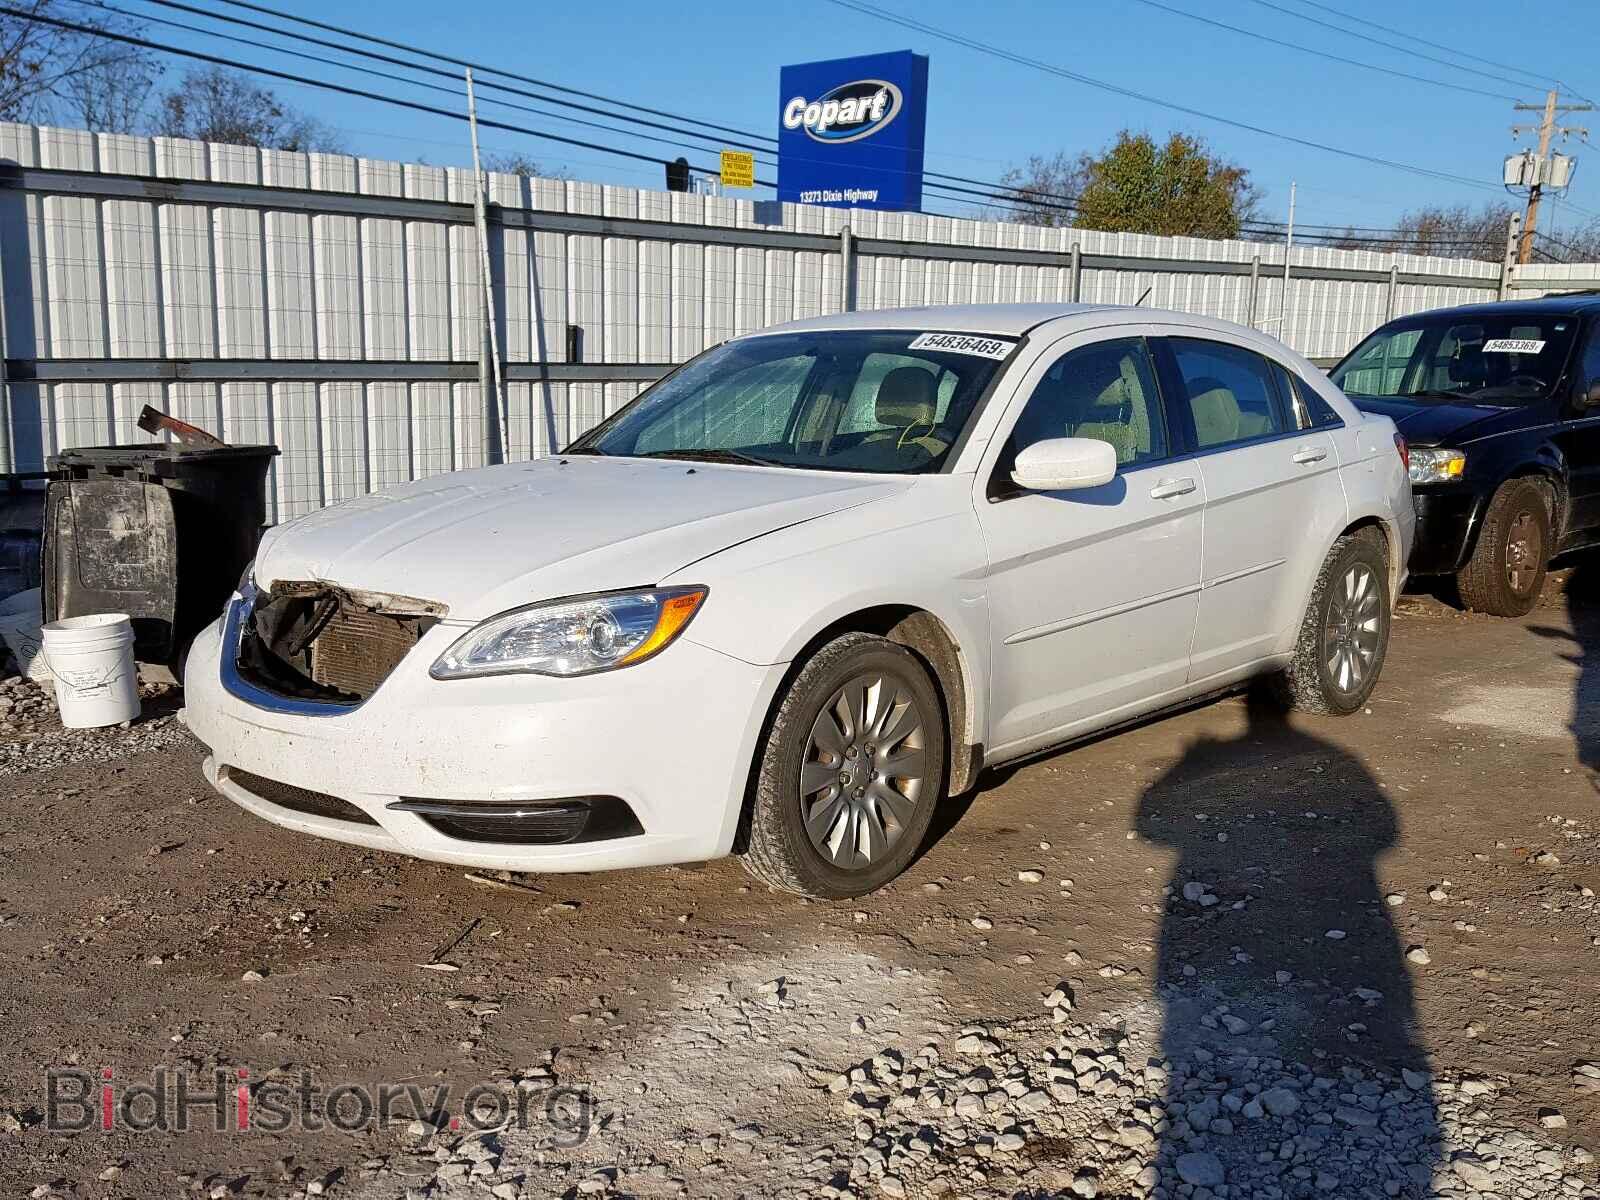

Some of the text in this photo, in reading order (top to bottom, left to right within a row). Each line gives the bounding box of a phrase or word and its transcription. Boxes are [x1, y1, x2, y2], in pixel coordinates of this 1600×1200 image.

[784, 87, 888, 133] Copart
[800, 188, 878, 204] 13273 Dixie Highway
